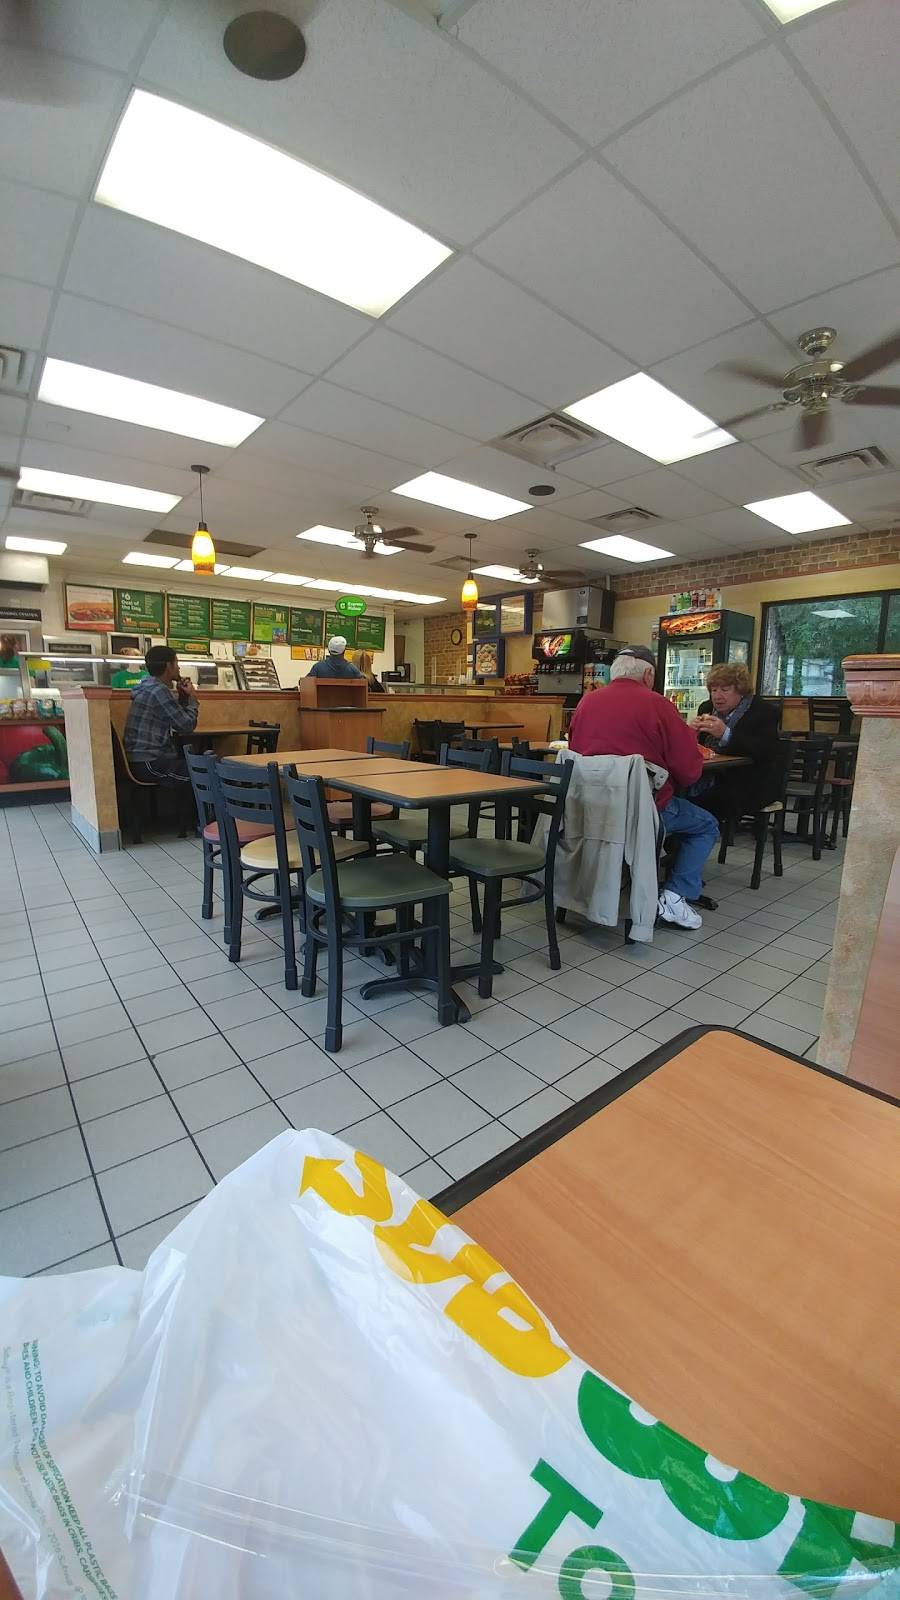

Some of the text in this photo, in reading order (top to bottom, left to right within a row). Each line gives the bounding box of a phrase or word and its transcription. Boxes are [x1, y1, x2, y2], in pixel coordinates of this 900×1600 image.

[34, 1371, 42, 1383] TO
[36, 1384, 46, 1411] AVOID
[23, 1361, 31, 1380] AND
[31, 1443, 40, 1459] NOT
[53, 1494, 67, 1518] BAGS
[62, 1518, 73, 1528] IN
[66, 1503, 81, 1526] KEEP
[76, 1525, 88, 1541] ALL
[85, 1541, 105, 1579] PLASTIC
